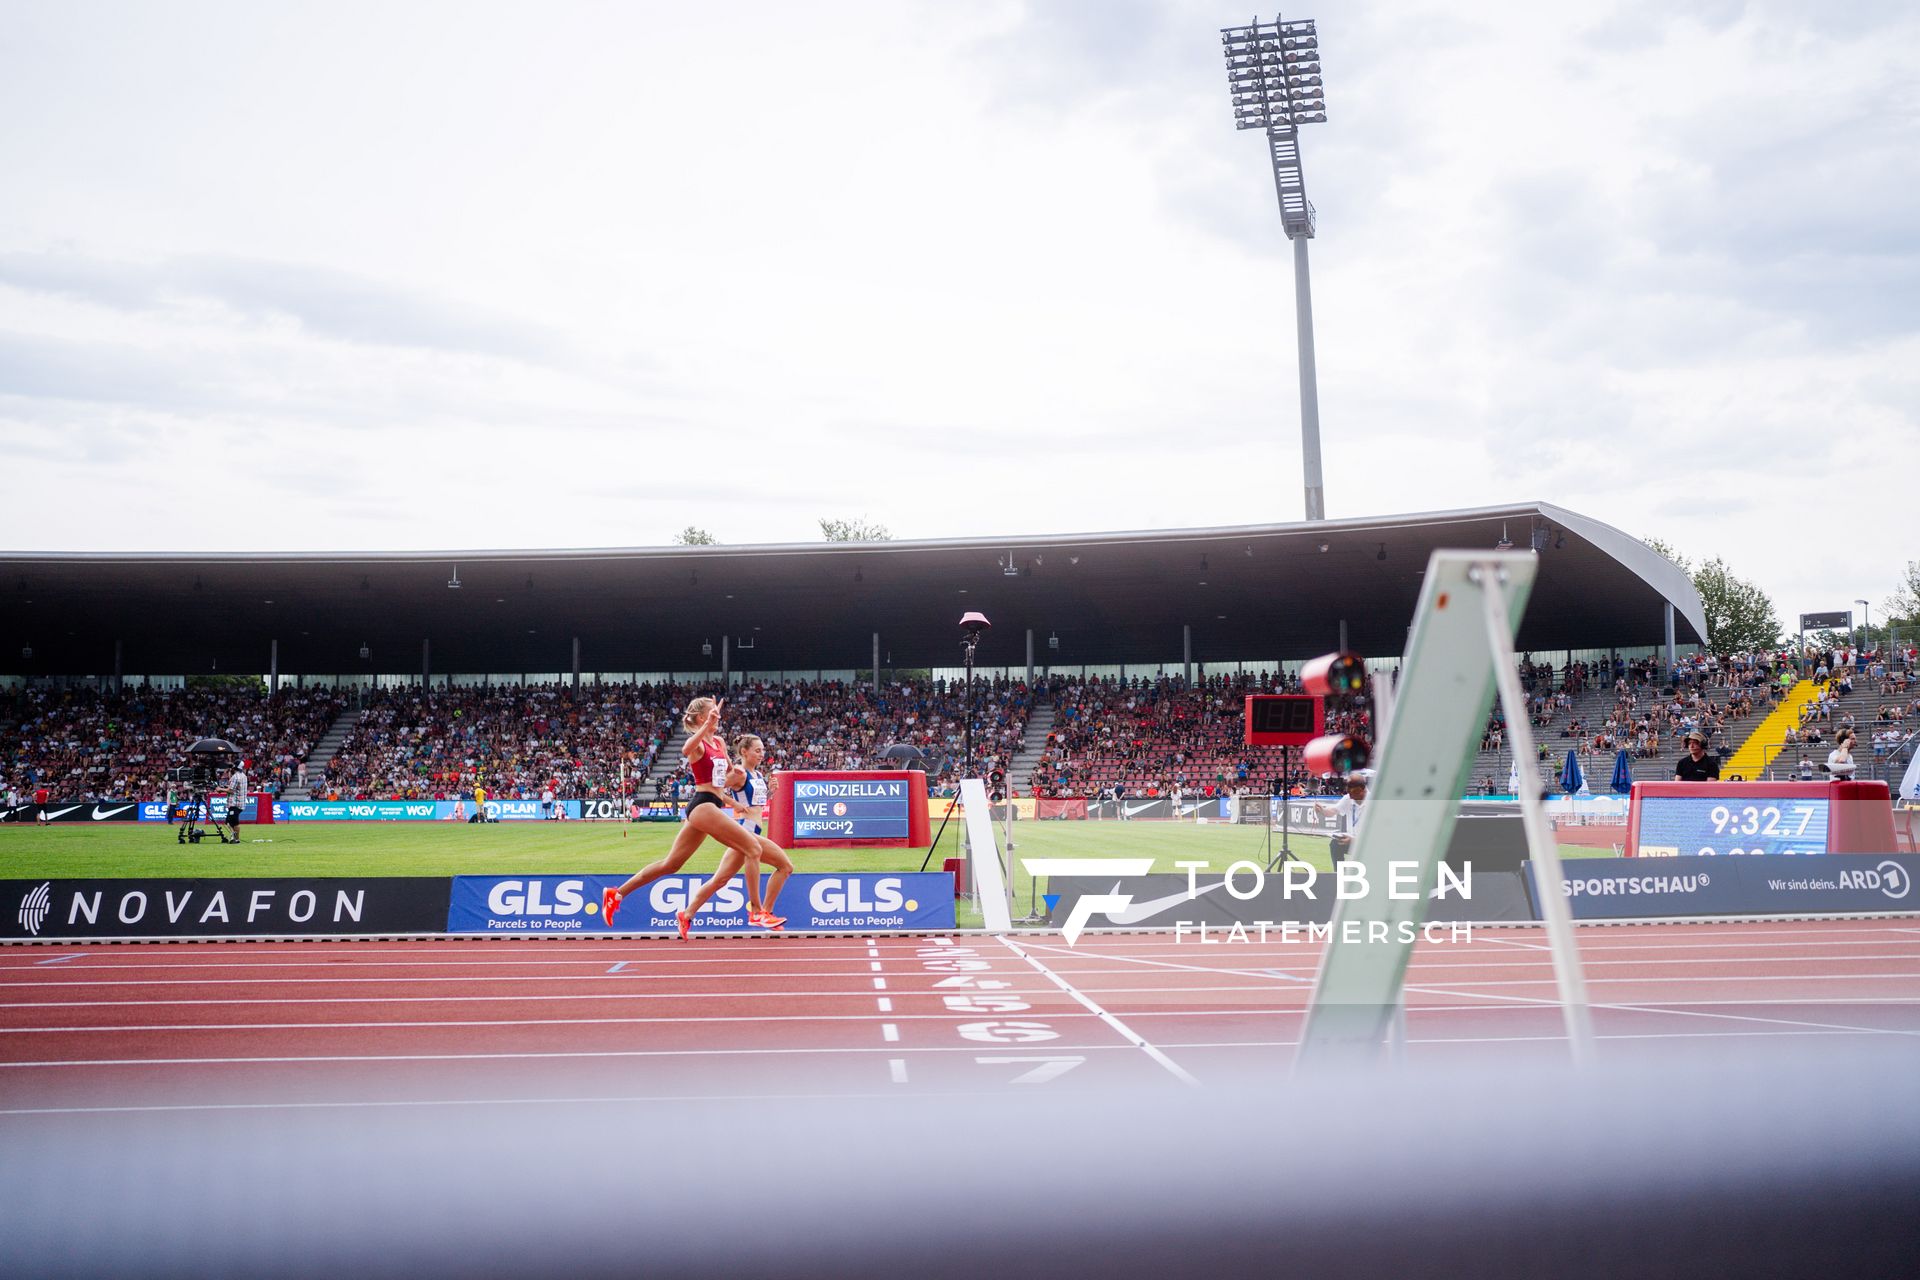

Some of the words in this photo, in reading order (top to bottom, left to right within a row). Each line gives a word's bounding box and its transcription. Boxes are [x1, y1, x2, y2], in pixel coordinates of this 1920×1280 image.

[797, 784, 886, 796] KONDZIELLA
[890, 784, 900, 796] N
[290, 805, 319, 816] WGV
[349, 805, 376, 816] WGV
[406, 805, 434, 816] WGV
[502, 803, 537, 813] PLAN
[803, 803, 827, 815] WE
[1710, 805, 1815, 836] 9:32.7
[1768, 879, 1786, 890] Wir
[1787, 879, 1807, 890] sind
[1809, 878, 1838, 890] deins.
[1839, 870, 1880, 889] ARD
[1561, 876, 1697, 897] SPORTSCHAU
[67, 890, 365, 925] NOVAFON
[488, 919, 527, 929] Parcels
[530, 919, 542, 929] to
[545, 919, 582, 930] People
[651, 917, 678, 927] Parce
[693, 917, 704, 926] to
[707, 916, 744, 928] People
[811, 916, 850, 926] Parcels
[853, 917, 864, 926] to
[867, 915, 903, 927] People
[956, 1022, 1063, 1043] 6
[974, 1056, 1087, 1084] 7
